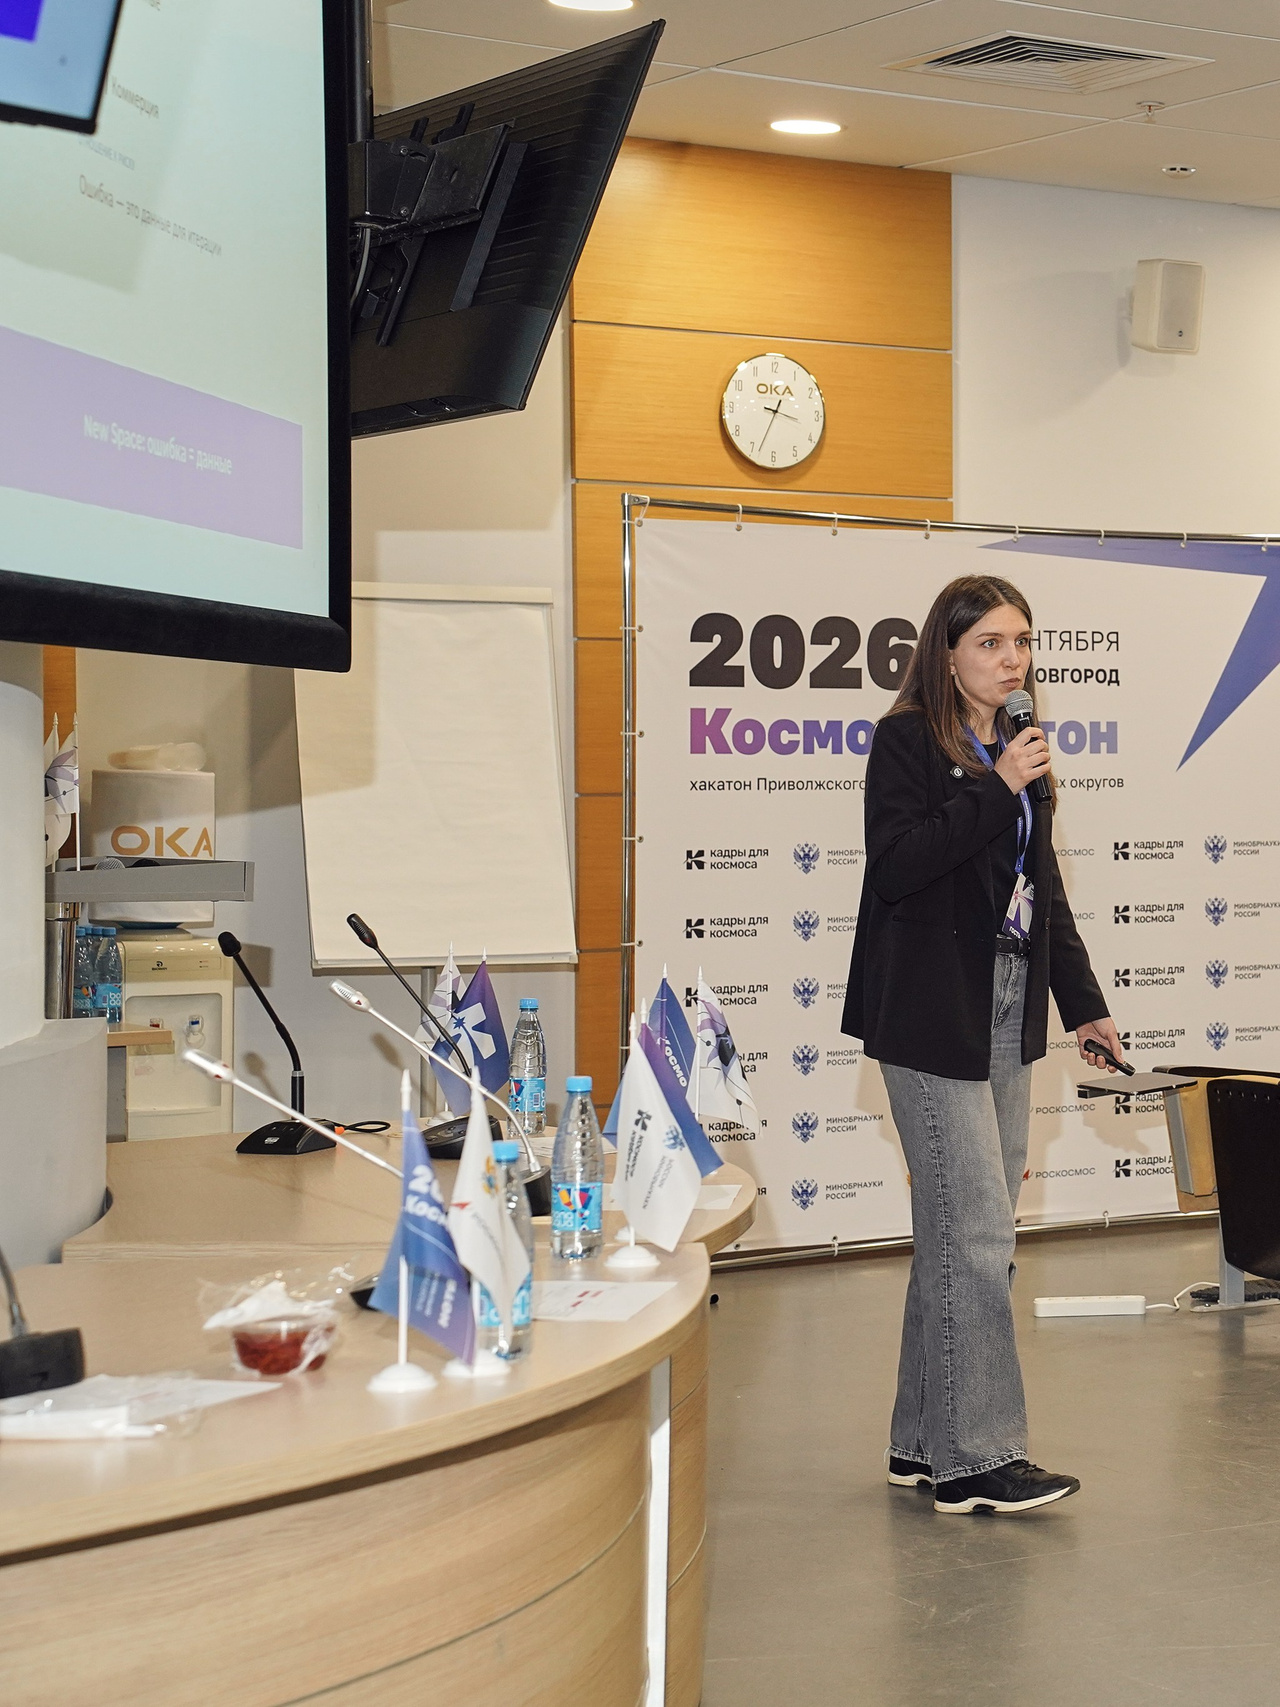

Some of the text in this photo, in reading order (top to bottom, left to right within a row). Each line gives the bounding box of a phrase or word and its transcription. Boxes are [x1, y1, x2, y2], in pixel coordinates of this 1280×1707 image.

[83, 414, 109, 442] New
[147, 436, 187, 463] ошибка
[196, 450, 233, 475] данные
[1030, 630, 1119, 652] НТЯБРЯ
[689, 611, 919, 692] 2026
[1035, 667, 1120, 686] ОВГОРОД
[689, 778, 752, 791] хакатон
[1070, 776, 1124, 791] округов
[1134, 840, 1184, 850] кадры для
[710, 848, 769, 859] кадры для
[827, 849, 864, 857] МИНОБРН
[1055, 848, 1095, 856] КОСМОС
[1134, 852, 1174, 860] космоса
[710, 860, 757, 870] космоса
[827, 857, 858, 866] РОССИИ
[1134, 903, 1184, 913] кадры для
[710, 916, 768, 927] кадры для
[1134, 914, 1175, 923] космоса
[709, 928, 757, 938] космоса
[1134, 965, 1185, 976] кадры для
[1134, 977, 1175, 986] космоса
[748, 984, 769, 993] для
[717, 996, 757, 1006] осмоса
[1135, 1028, 1185, 1039] кадры для
[1235, 1034, 1262, 1042] РОССИИ
[1135, 1040, 1176, 1050] космоса
[827, 1049, 864, 1057] МИНОБРН
[827, 1058, 858, 1066] РОССИИ
[1036, 1103, 1096, 1114] РОСКОСМОС
[1135, 1104, 1164, 1113] космо
[826, 1114, 884, 1125] МИНОБРНАУКИ
[826, 1125, 857, 1133] РОССИИ
[1135, 1156, 1167, 1166] кадры
[1036, 1167, 1096, 1179] РОСКОСМОС
[826, 1181, 884, 1192] МИНОБРНАУКИ
[825, 1192, 857, 1200] РОССИИ
